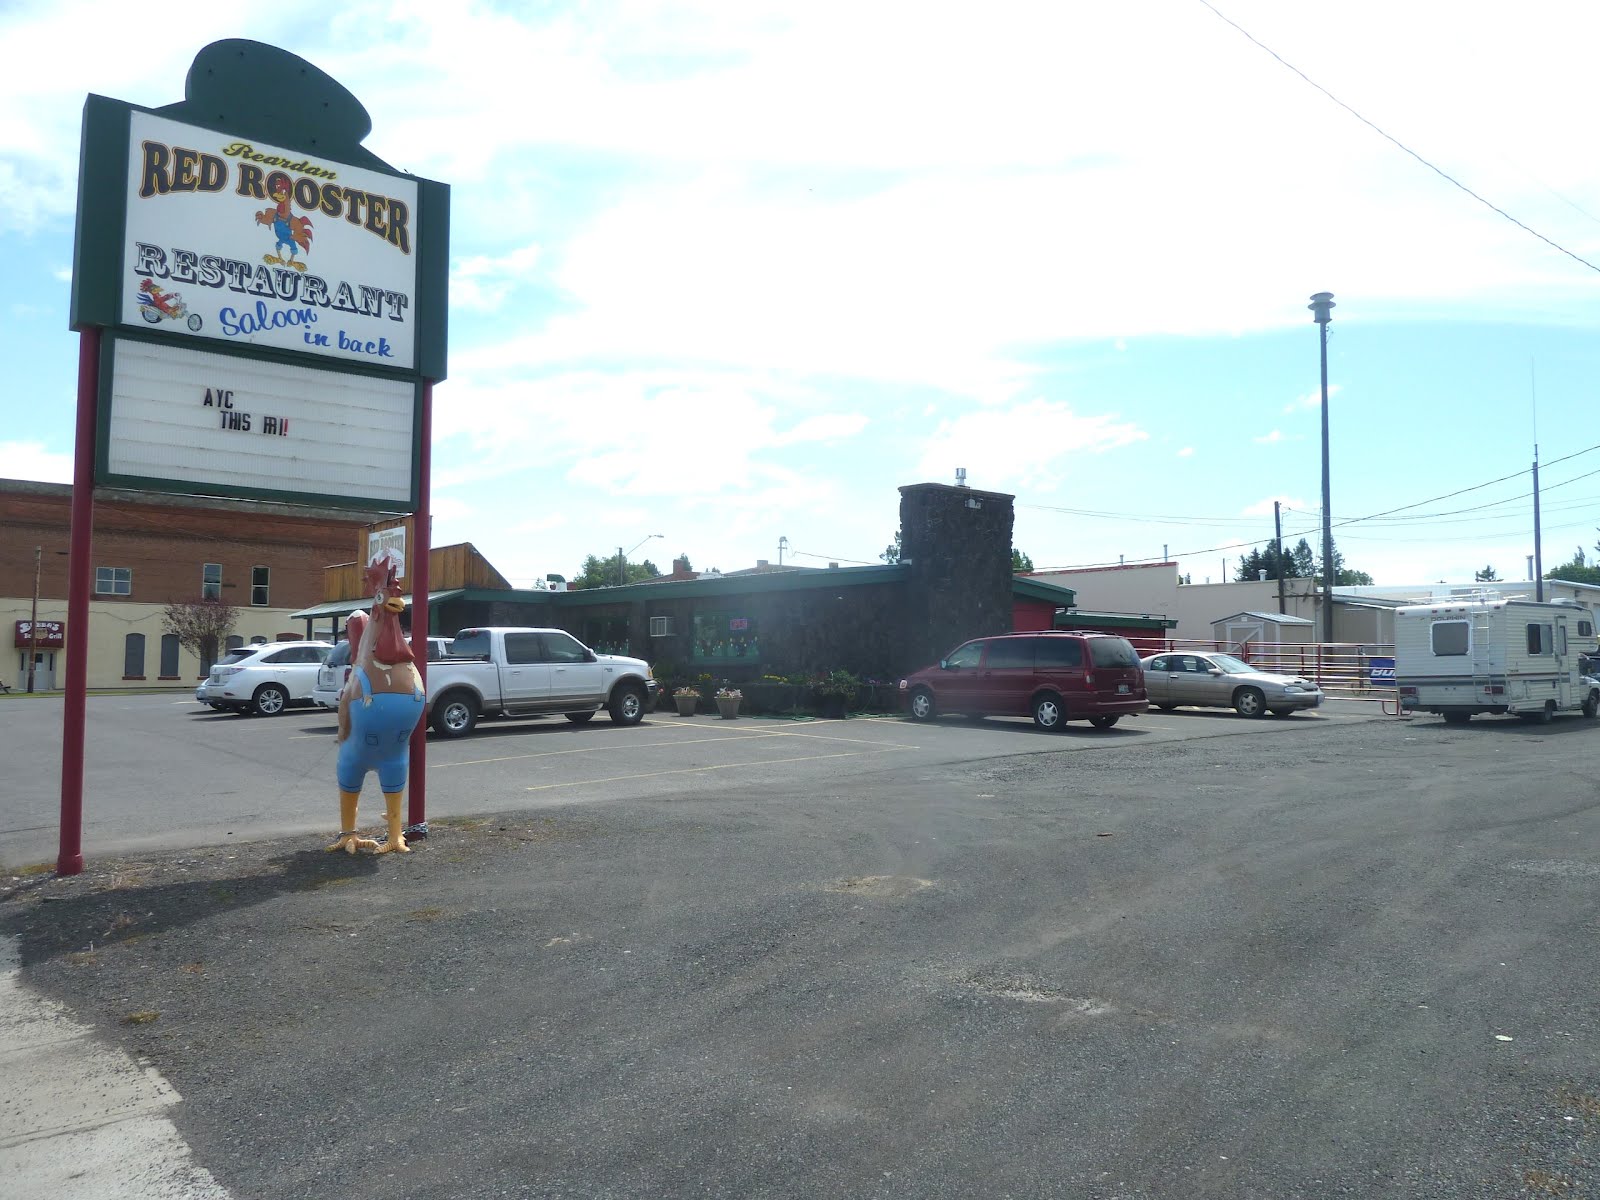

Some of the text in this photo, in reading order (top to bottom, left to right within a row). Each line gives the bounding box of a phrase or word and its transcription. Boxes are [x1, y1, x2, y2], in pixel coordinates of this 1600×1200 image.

[222, 142, 337, 181] Reardan
[139, 140, 411, 255] RED ROOSTER
[135, 242, 409, 322] RESTAURANT
[219, 301, 318, 336] Saloon
[303, 325, 395, 358] in back
[220, 410, 251, 432] THIS
